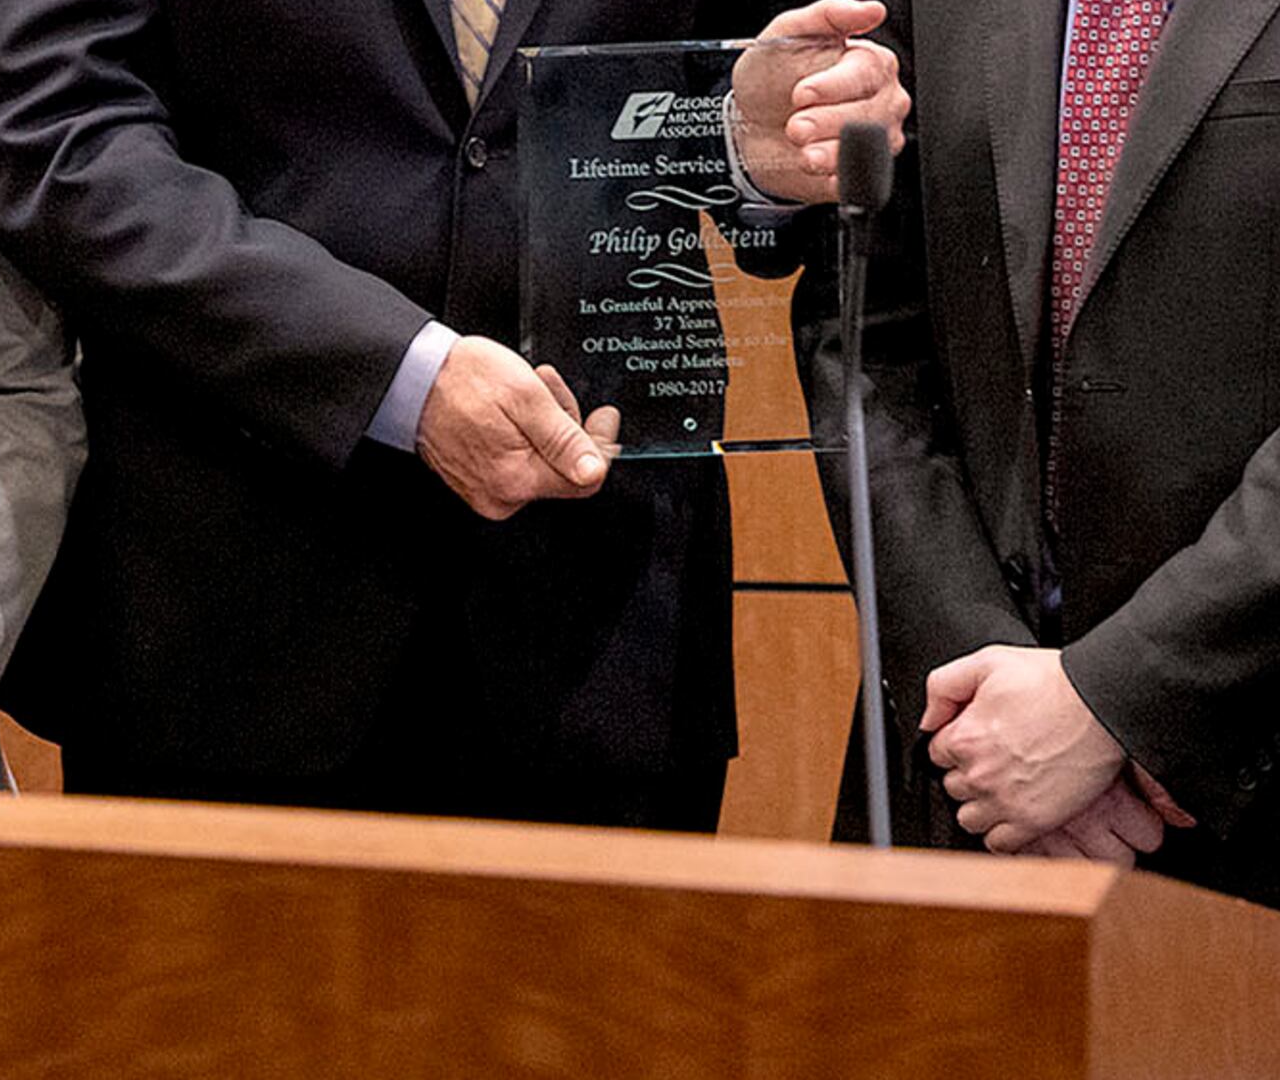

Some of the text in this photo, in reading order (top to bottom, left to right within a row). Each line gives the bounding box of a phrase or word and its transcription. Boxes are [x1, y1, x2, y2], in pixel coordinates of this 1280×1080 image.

[672, 96, 723, 110] GEORG
[658, 123, 749, 139] ASSOCIATON
[570, 157, 650, 178] Lifetime
[655, 155, 725, 176] Service
[589, 225, 661, 260] Philip
[579, 299, 597, 314] In
[599, 297, 663, 313] Grateful
[653, 315, 717, 331] 37 Years
[582, 337, 605, 353] Of
[607, 336, 682, 352] Dedicated
[626, 355, 659, 372] City
[661, 354, 680, 370] of
[648, 380, 725, 397] 1980-2017
